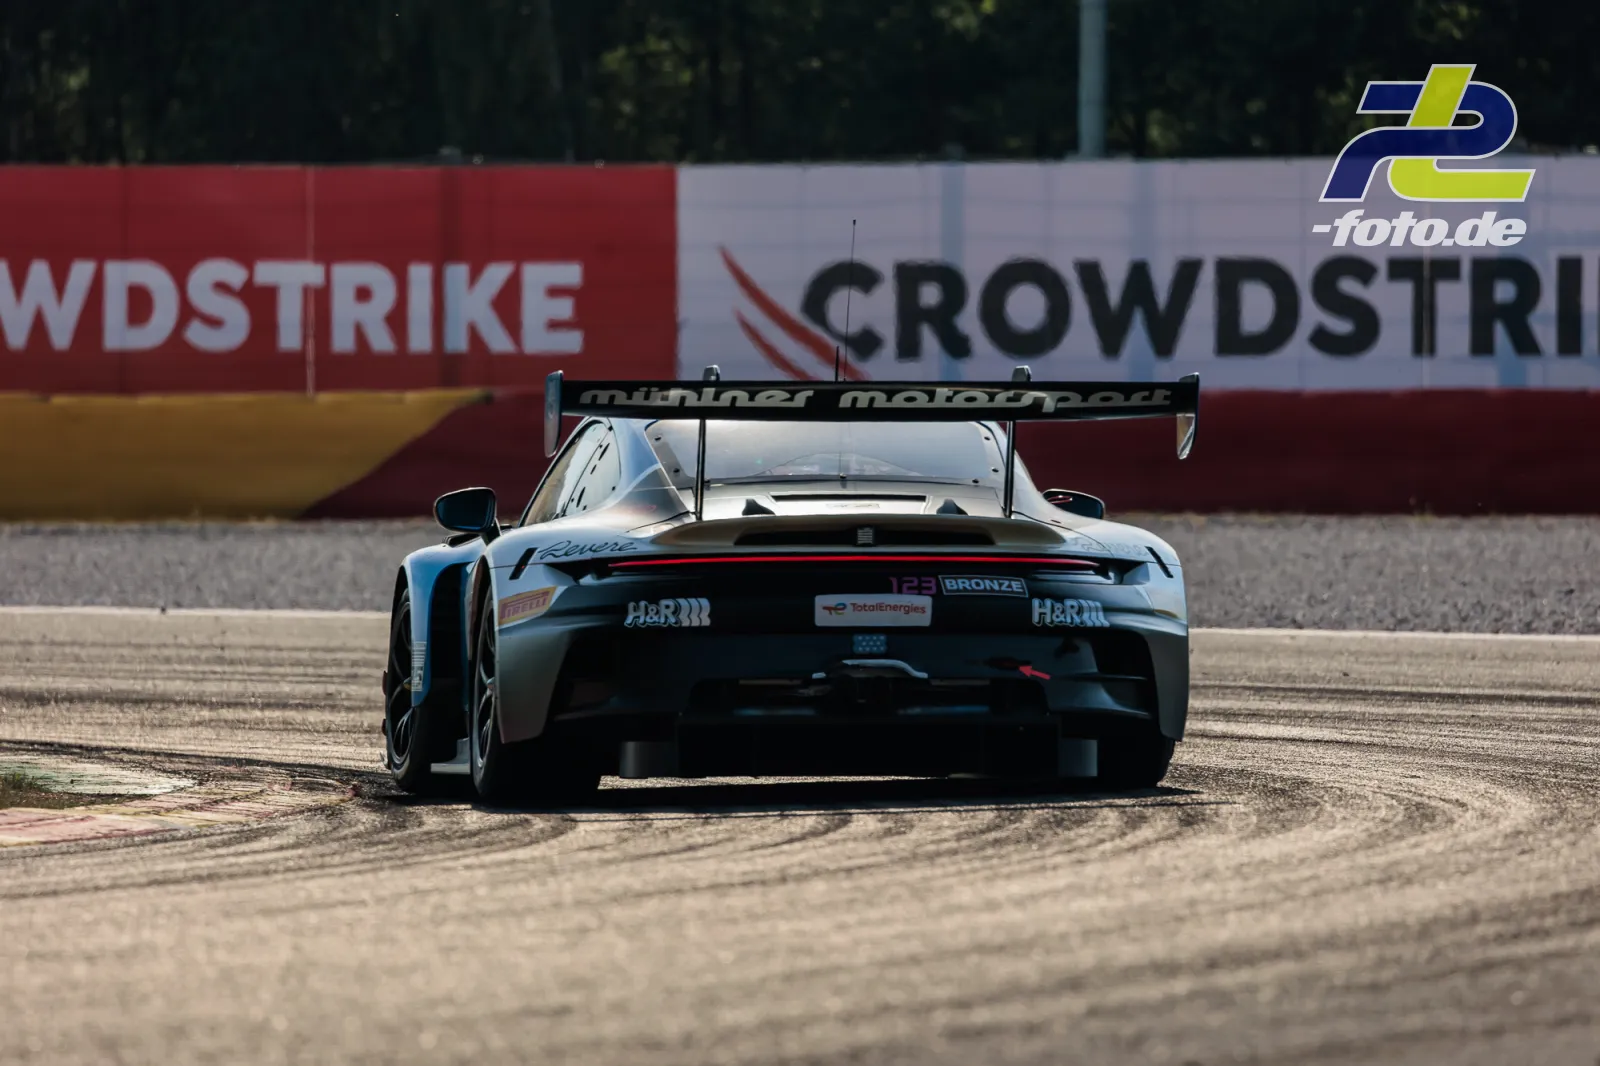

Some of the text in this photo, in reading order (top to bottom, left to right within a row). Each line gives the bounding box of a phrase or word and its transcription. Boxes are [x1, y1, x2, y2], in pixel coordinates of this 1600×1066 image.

[801, 255, 1600, 361] CROWDSTRI
[579, 387, 1173, 412] mühlner motorsport
[889, 576, 1023, 595] 123 BRONZE
[500, 591, 550, 620] PIRELLI
[624, 599, 680, 628] H&R
[850, 602, 927, 615] TotalEnergies
[1031, 598, 1086, 627] H&R
